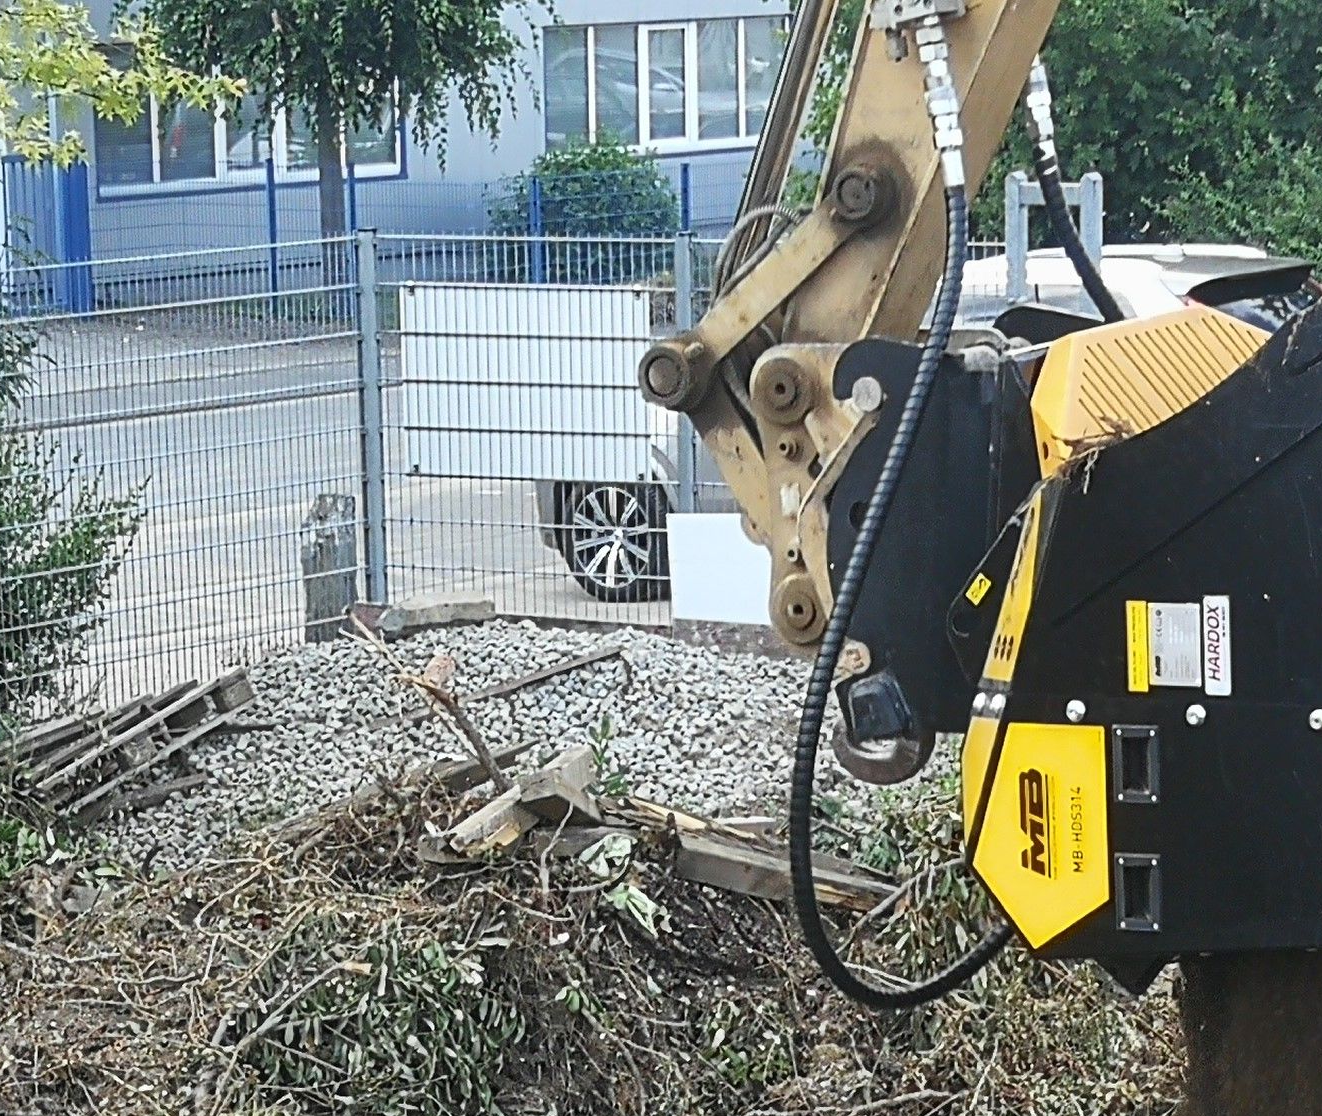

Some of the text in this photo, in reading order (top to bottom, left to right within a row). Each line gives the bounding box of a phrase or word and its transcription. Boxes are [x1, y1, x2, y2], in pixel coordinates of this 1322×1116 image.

[1206, 604, 1221, 682] HARDOX
[1018, 768, 1046, 876] MB
[1070, 786, 1084, 873] MB-HDS314
